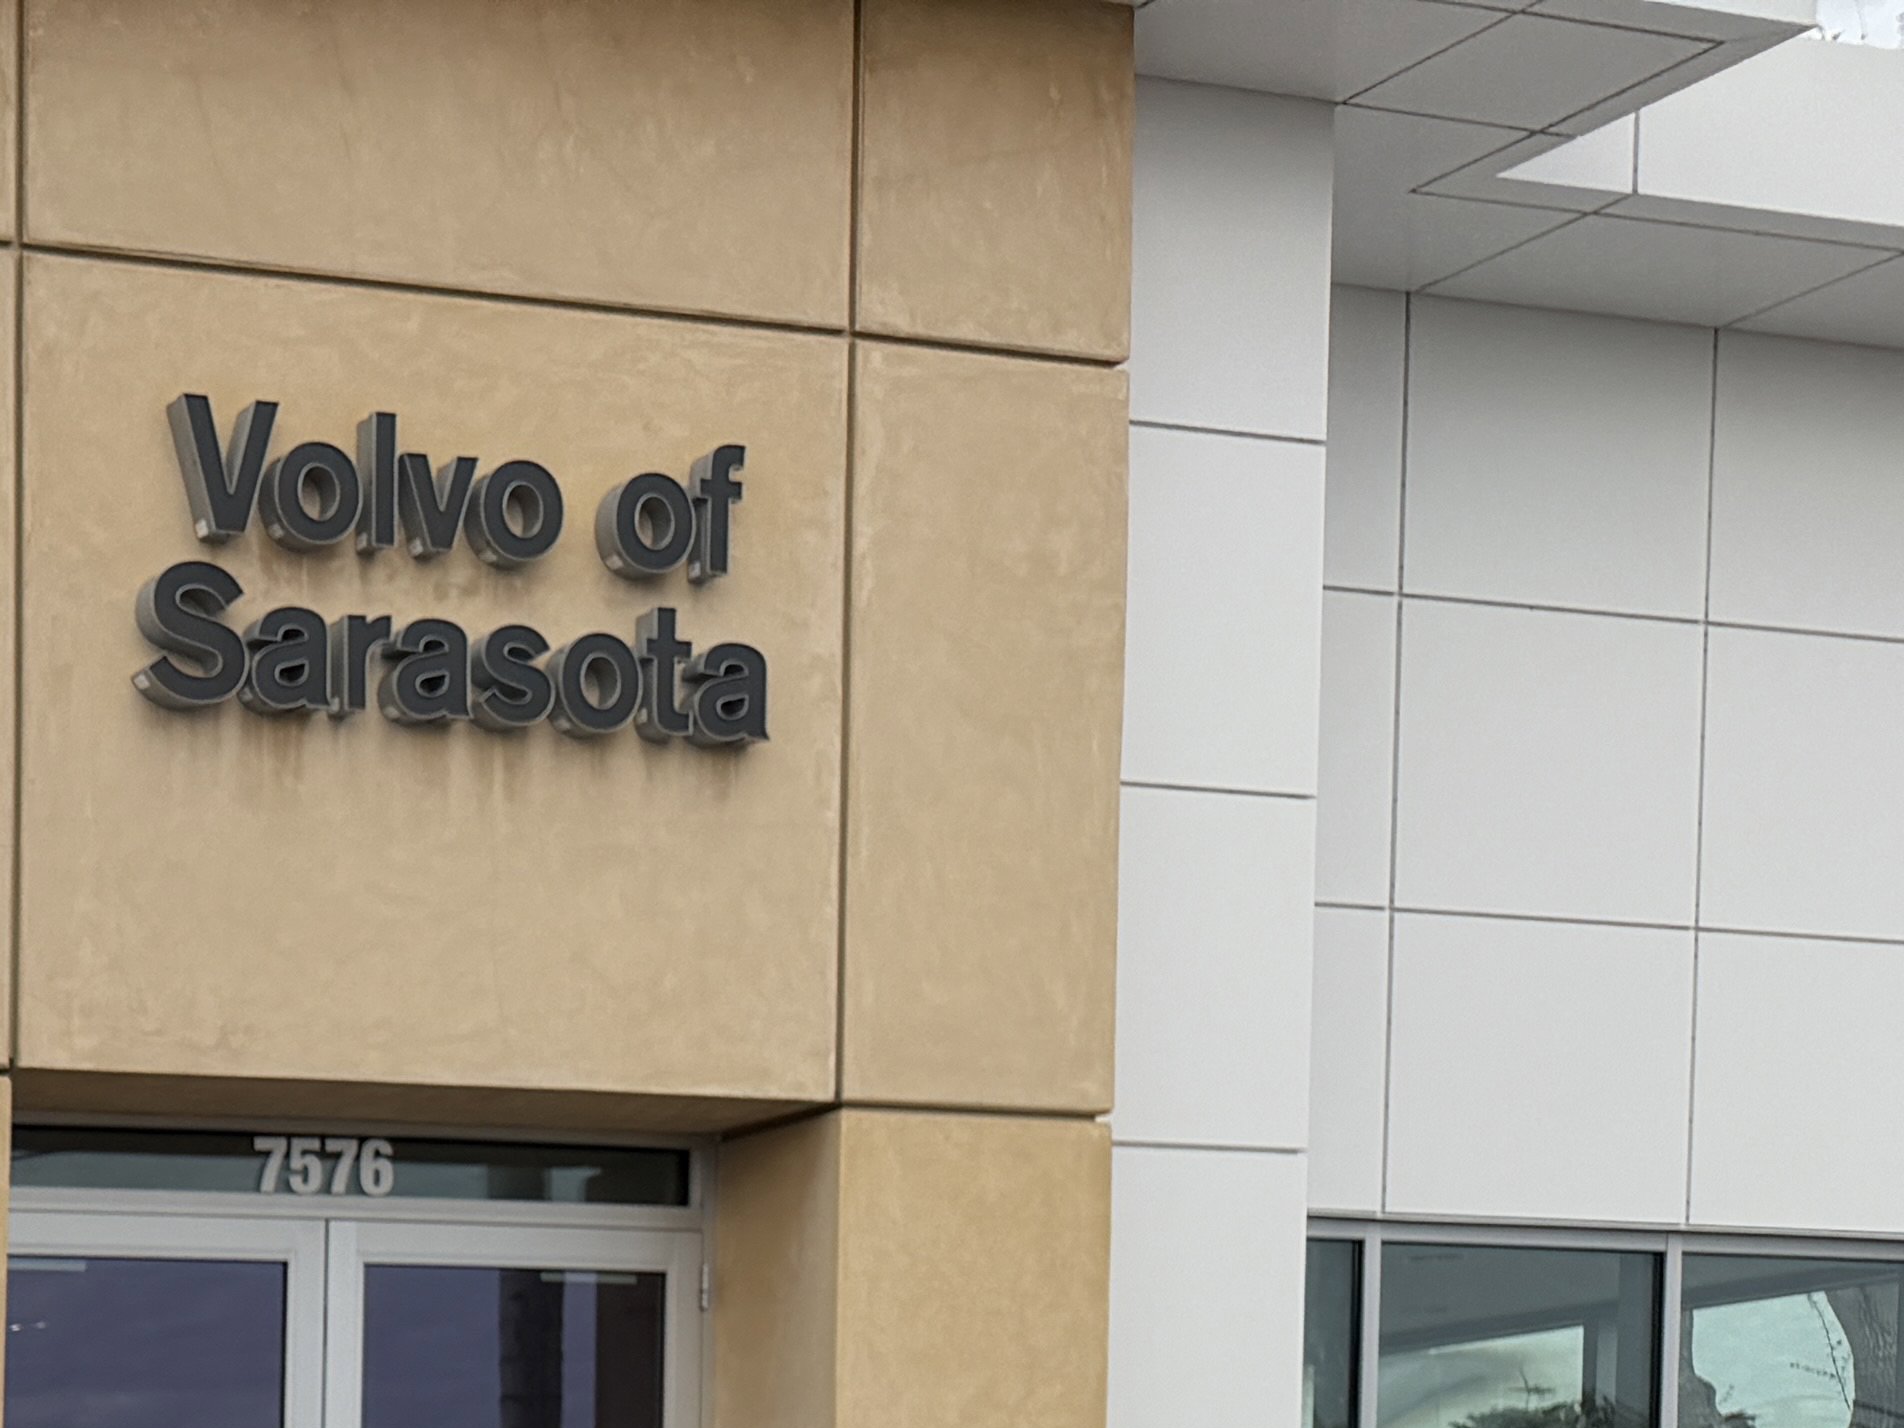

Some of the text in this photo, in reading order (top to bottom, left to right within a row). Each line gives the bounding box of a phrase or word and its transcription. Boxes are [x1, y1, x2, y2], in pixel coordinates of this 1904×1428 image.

[165, 393, 745, 584] Volvo of
[131, 561, 770, 750] Sarasota
[253, 1137, 395, 1196] 7576
